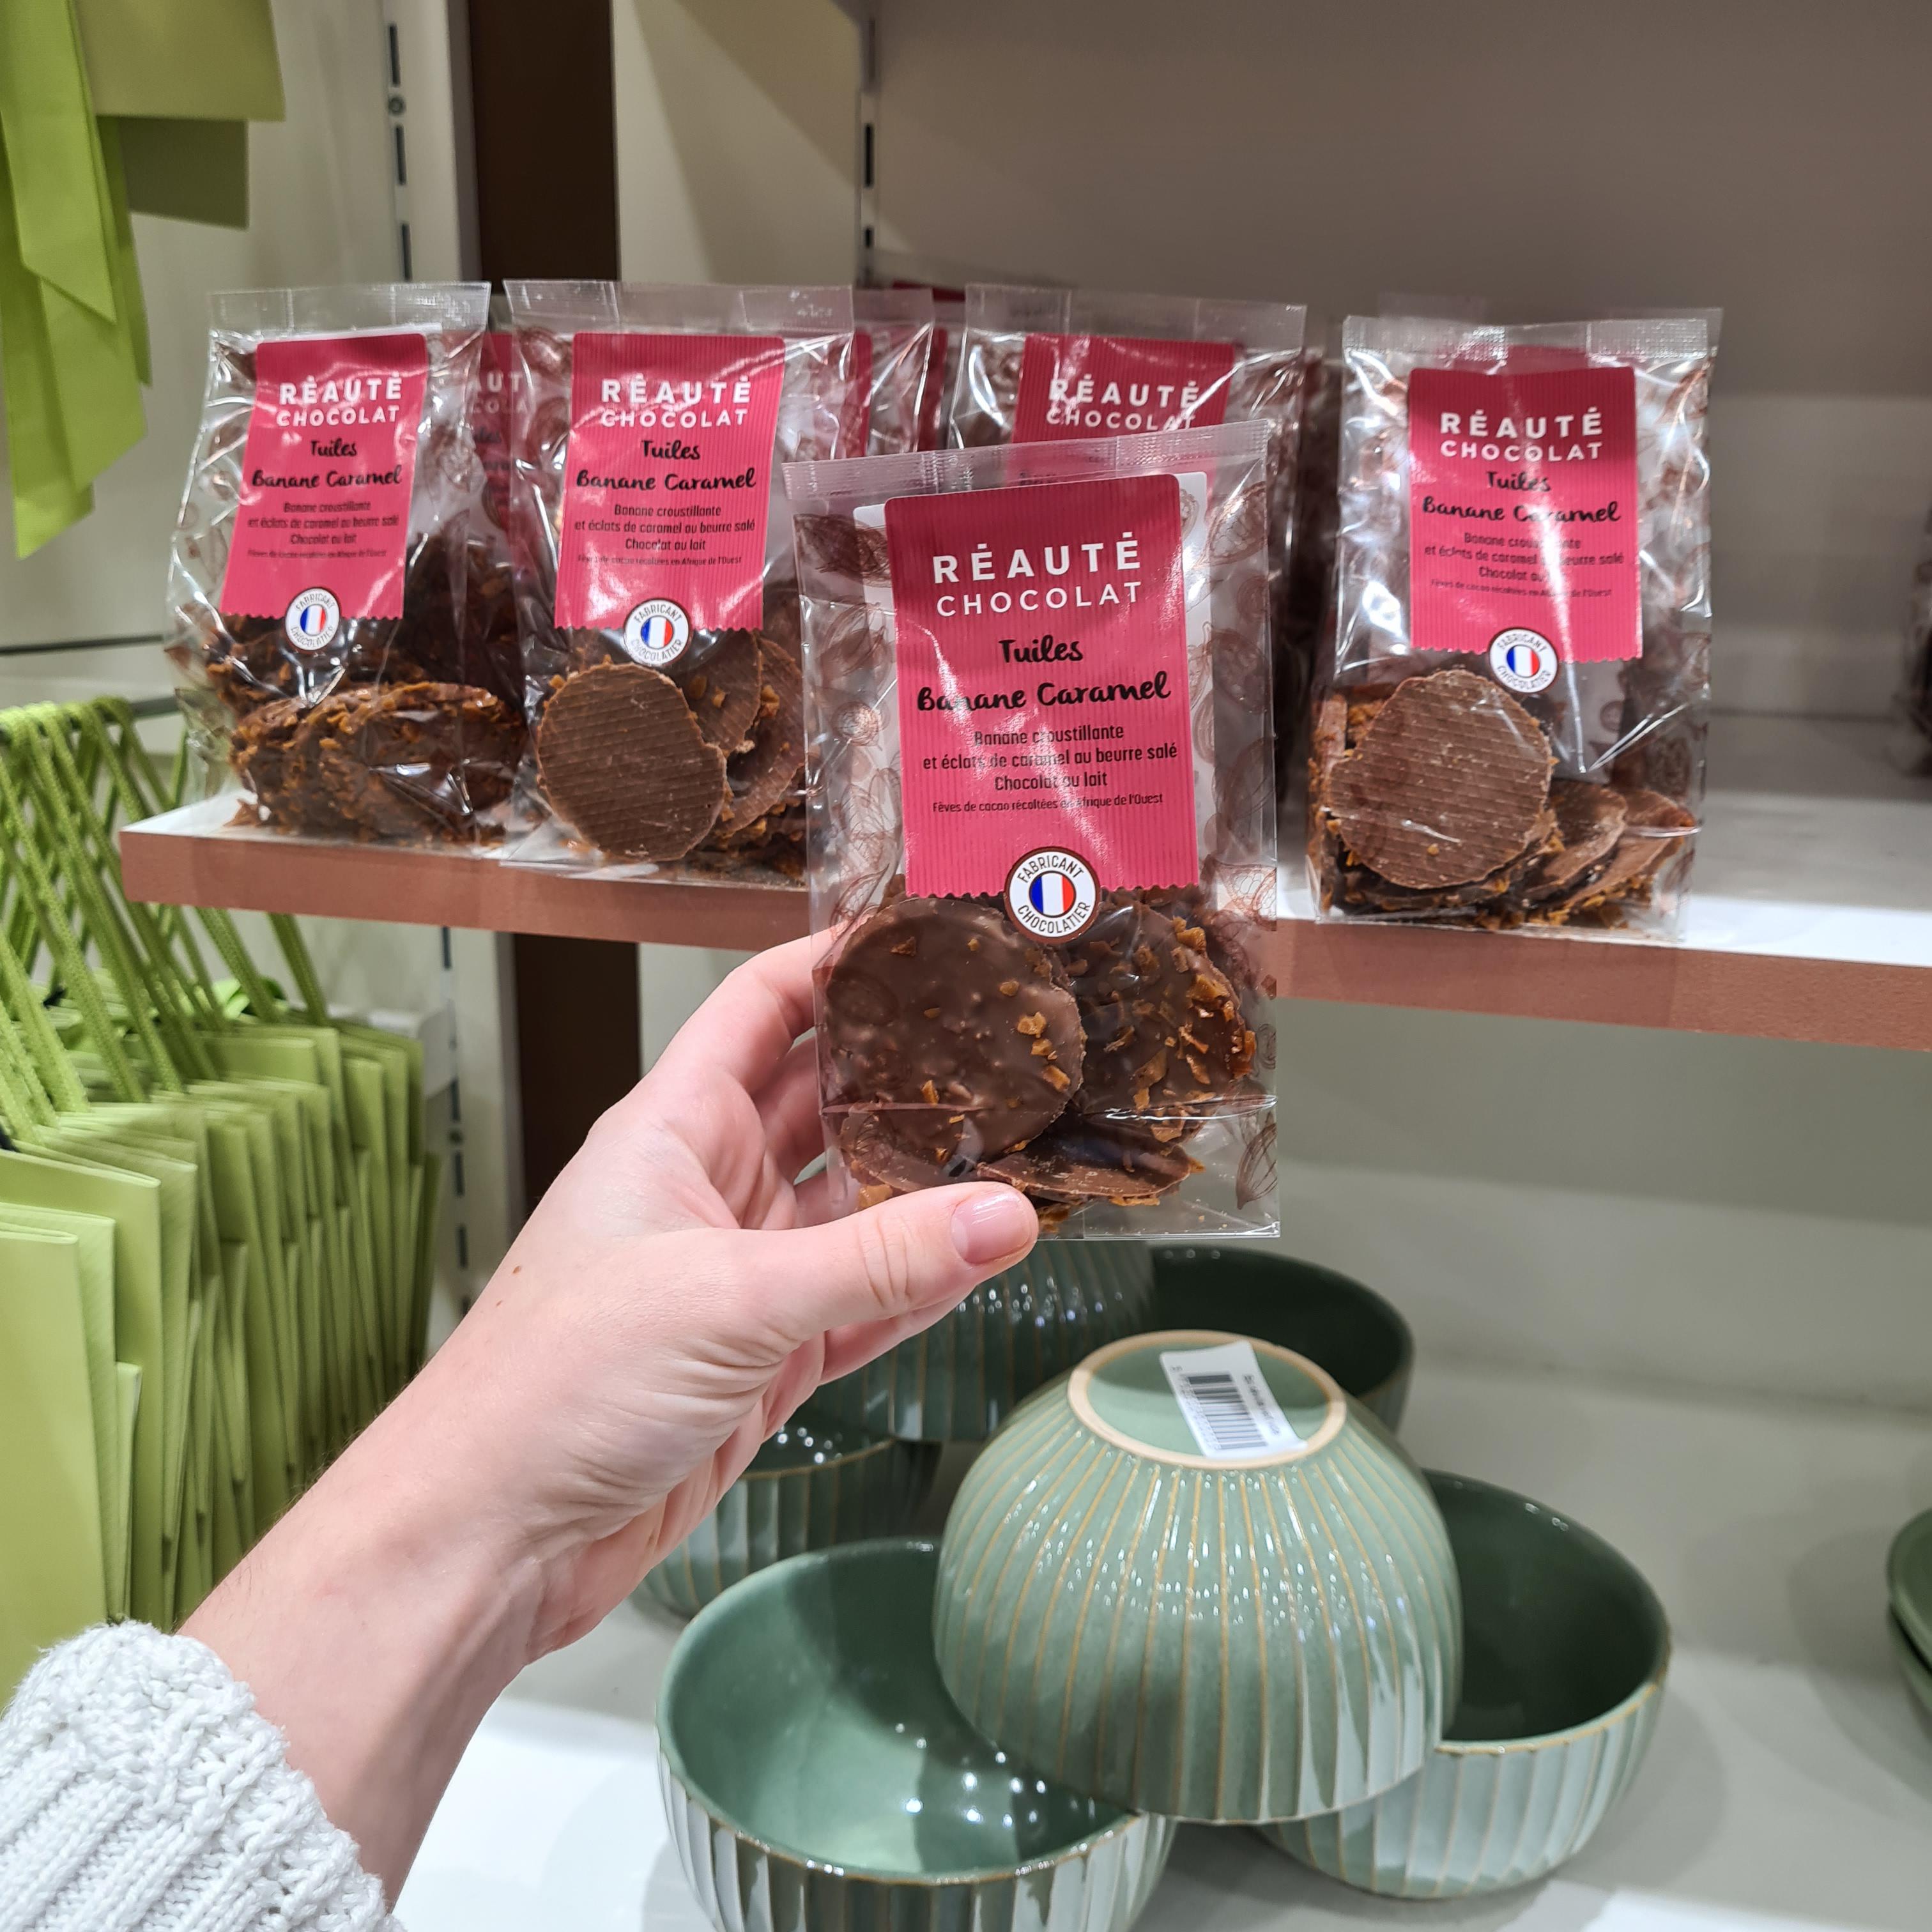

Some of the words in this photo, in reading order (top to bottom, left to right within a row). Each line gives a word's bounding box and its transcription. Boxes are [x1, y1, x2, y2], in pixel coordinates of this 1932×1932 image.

[279, 371, 402, 405] RÉAUTÉ
[601, 373, 751, 404] RÉAUTÉ
[276, 405, 400, 427] CHOCOLAT
[601, 408, 748, 429] CHOCOLAT
[1440, 406, 1602, 439] RÉAUTÉ
[310, 438, 357, 457] Tuiles
[641, 440, 701, 460] Tuiles
[1440, 440, 1602, 462] CHOCOLAT
[251, 469, 320, 488] Banane
[326, 464, 402, 487] Caramel
[576, 469, 657, 490] Banane
[664, 467, 756, 491] Caramel
[1487, 471, 1551, 492] Tuiles
[614, 503, 654, 516] Banane
[656, 504, 721, 517] croustillante
[1422, 496, 1505, 521] Banane
[575, 521, 585, 530] et
[588, 520, 620, 532] éclats
[624, 521, 636, 532] de
[640, 521, 682, 534] caramel
[685, 523, 697, 533] au
[700, 521, 732, 533] beurre
[735, 518, 755, 532] salé
[625, 538, 671, 551] Chocolat
[674, 540, 687, 550] au
[689, 539, 706, 551] lait
[1464, 532, 1505, 546] Banane
[932, 532, 1140, 584] RÉAUTÉ
[1424, 545, 1436, 555] et
[1476, 549, 1489, 561] de
[1491, 553, 1537, 564] caramel
[1478, 565, 1527, 581] Chocolat
[936, 581, 1142, 617] CHOCOLAT
[634, 604, 683, 623] FABRICANT
[631, 638, 683, 661] CHOCOLATIER
[999, 634, 1084, 663] Tuiles
[917, 686, 1026, 711] Banane
[1037, 670, 1172, 707] Caramel
[974, 731, 1027, 746] Banane
[923, 756, 937, 769] et
[940, 754, 985, 769] éclats
[990, 753, 1007, 767] de
[1011, 749, 1070, 767] caramel
[1074, 752, 1092, 764] au
[1096, 747, 1143, 763] beurre
[1147, 742, 1177, 760] salé
[995, 774, 1058, 791] Chocolat
[1062, 775, 1080, 787] au
[1084, 771, 1108, 787] lait
[933, 801, 962, 813] Fèves
[964, 801, 977, 812] de
[979, 802, 1009, 811] cacao
[1011, 799, 1058, 811] récoltées
[1114, 795, 1127, 806] de
[1129, 793, 1163, 805] l'Ouest
[1017, 855, 1084, 884] FABRICANT
[1018, 901, 1091, 933] CHOCOLATIER
